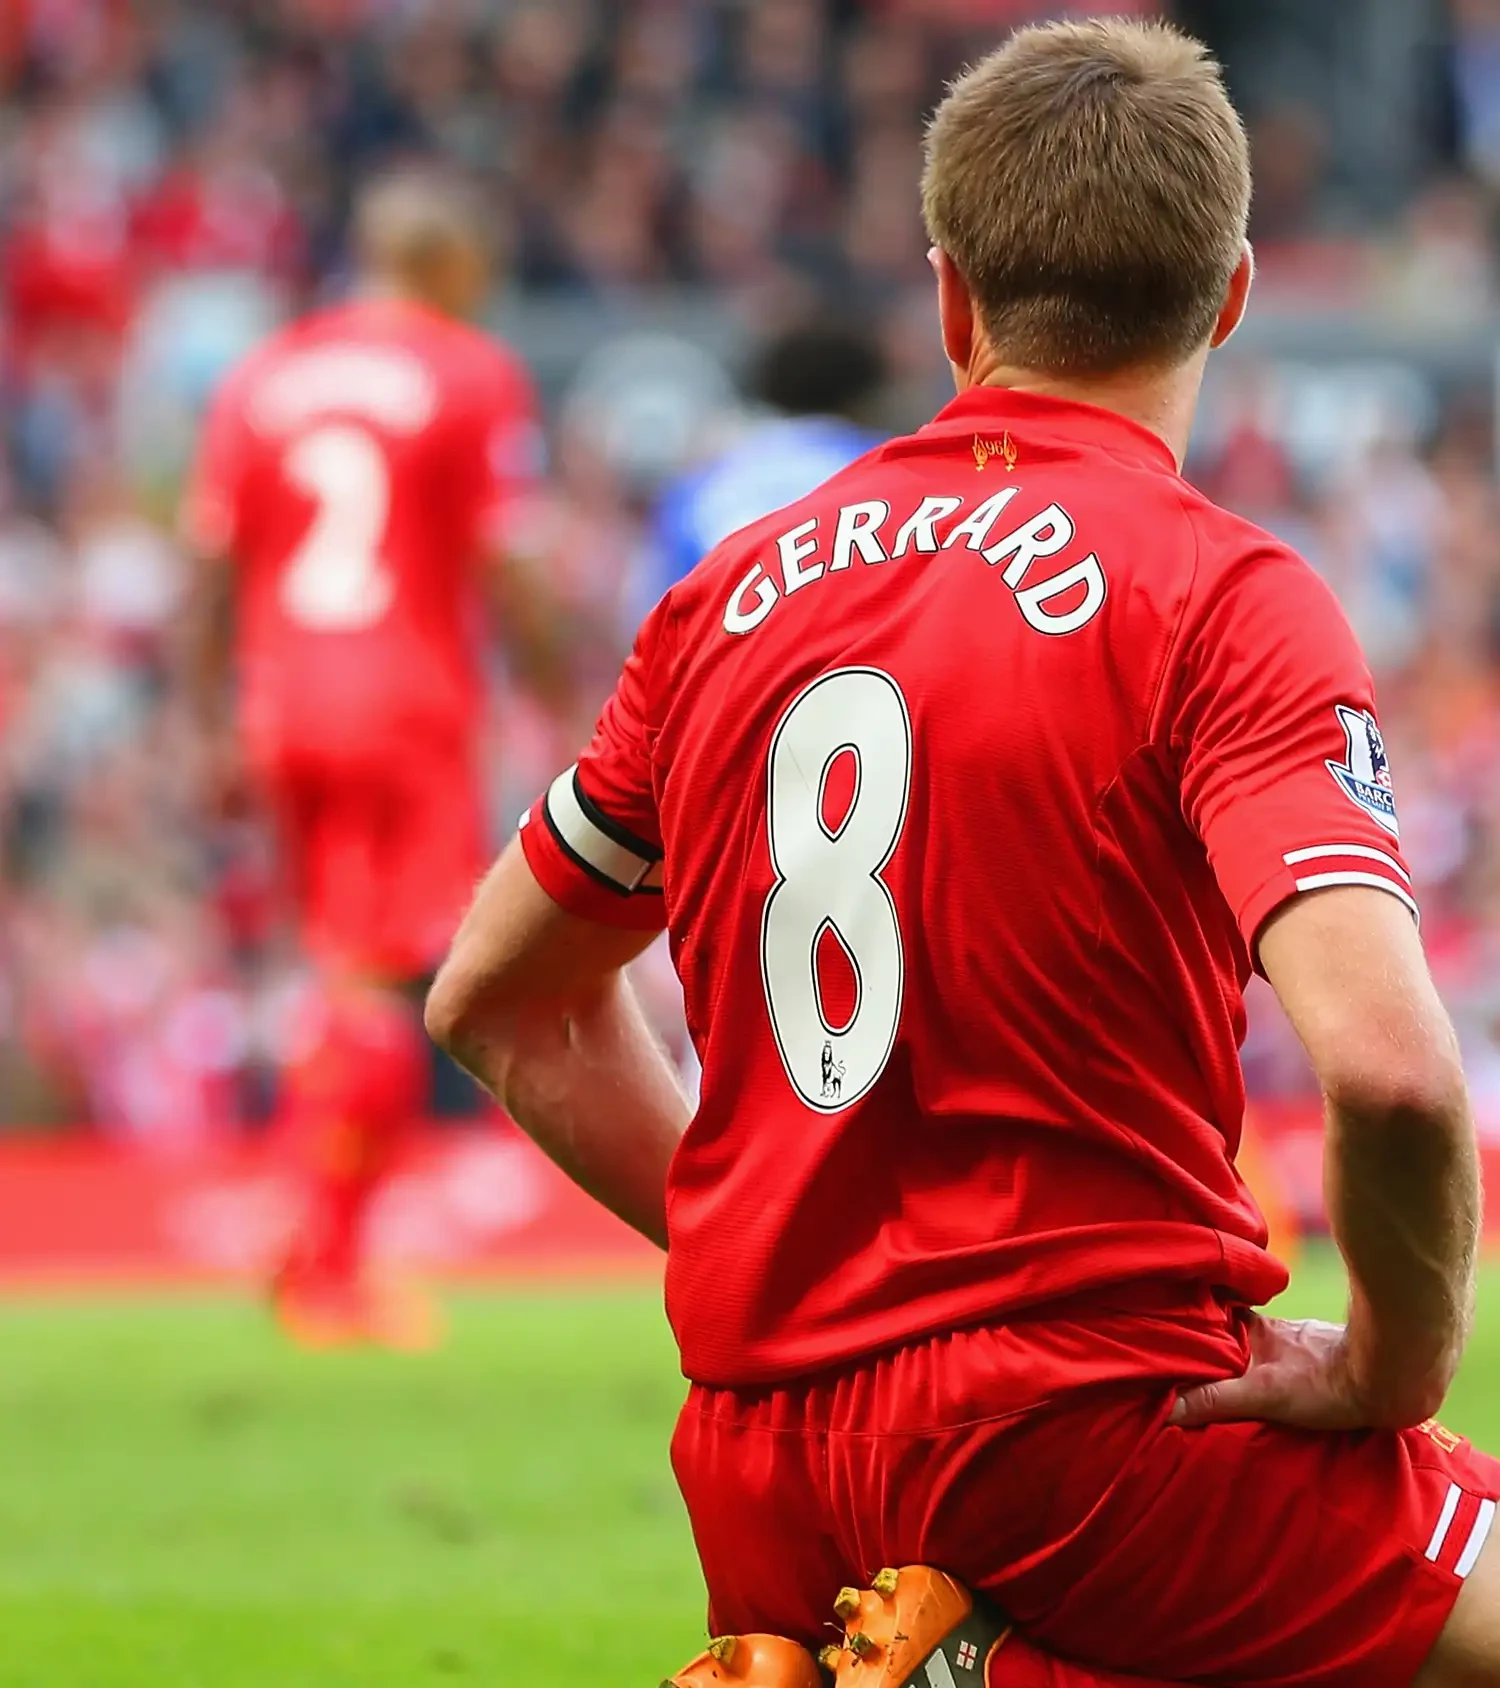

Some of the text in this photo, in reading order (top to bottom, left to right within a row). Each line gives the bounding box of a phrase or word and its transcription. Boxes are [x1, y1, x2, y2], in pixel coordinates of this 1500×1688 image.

[985, 440, 1004, 456] 96
[282, 424, 396, 634] 2
[721, 486, 1107, 636] GERRARD
[1354, 781, 1396, 808] BARC
[760, 665, 913, 1115] 8
